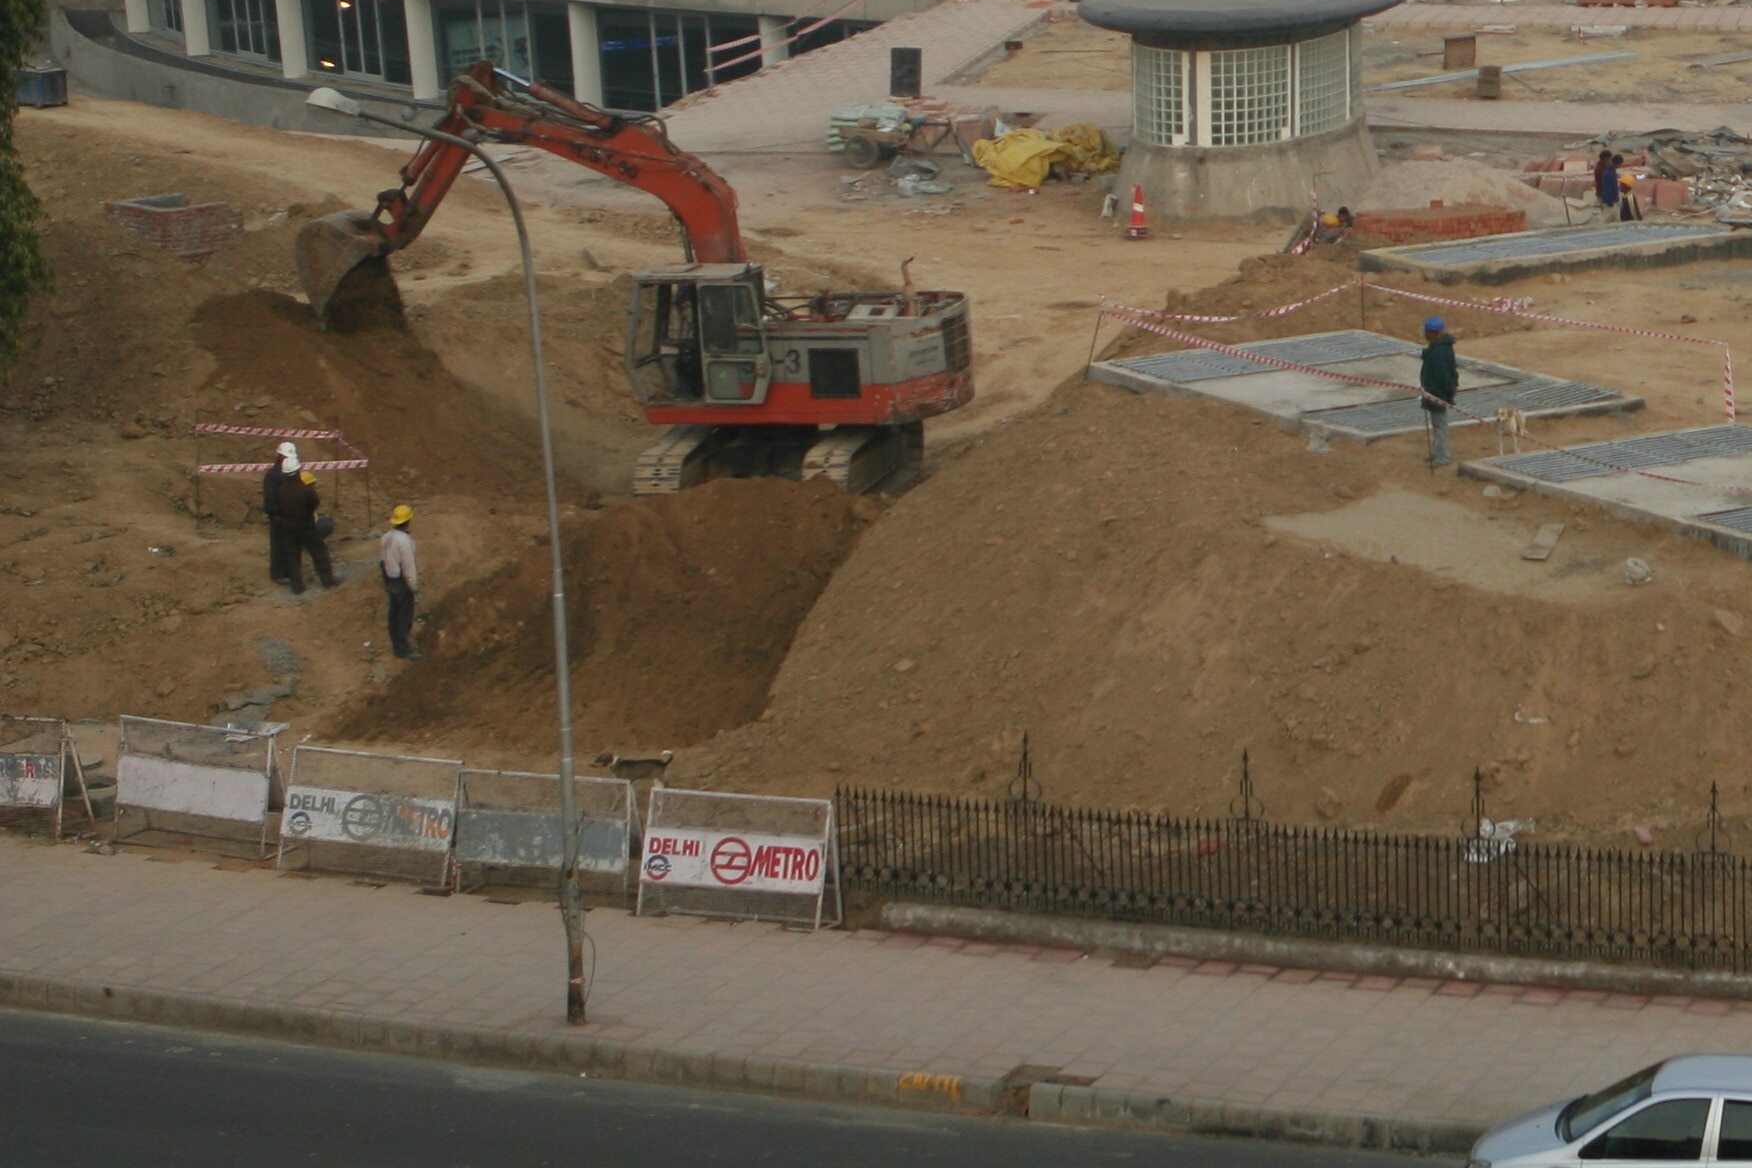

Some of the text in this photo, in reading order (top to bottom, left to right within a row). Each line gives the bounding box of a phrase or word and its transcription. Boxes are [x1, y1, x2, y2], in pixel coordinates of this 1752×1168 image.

[289, 793, 336, 815] DELHI
[648, 836, 820, 882] DELHI METRO
